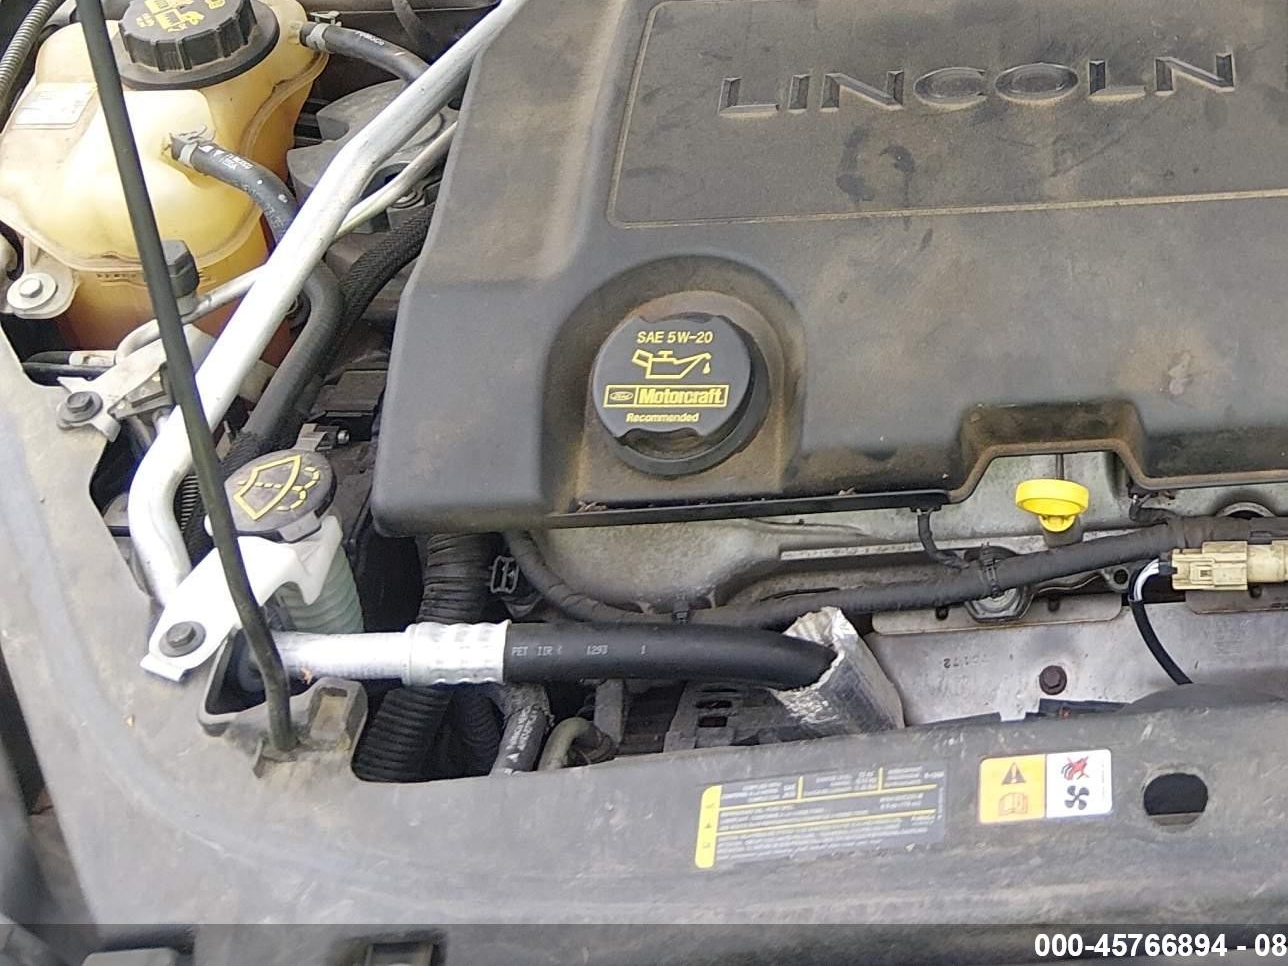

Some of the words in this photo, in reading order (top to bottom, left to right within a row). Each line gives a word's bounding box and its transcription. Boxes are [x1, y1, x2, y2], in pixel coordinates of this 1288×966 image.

[718, 52, 1237, 118] LINCOLN
[637, 331, 664, 344] SAE
[667, 331, 713, 345] 5W-20
[638, 387, 723, 405] Motorcraft
[626, 412, 699, 424] Recommended
